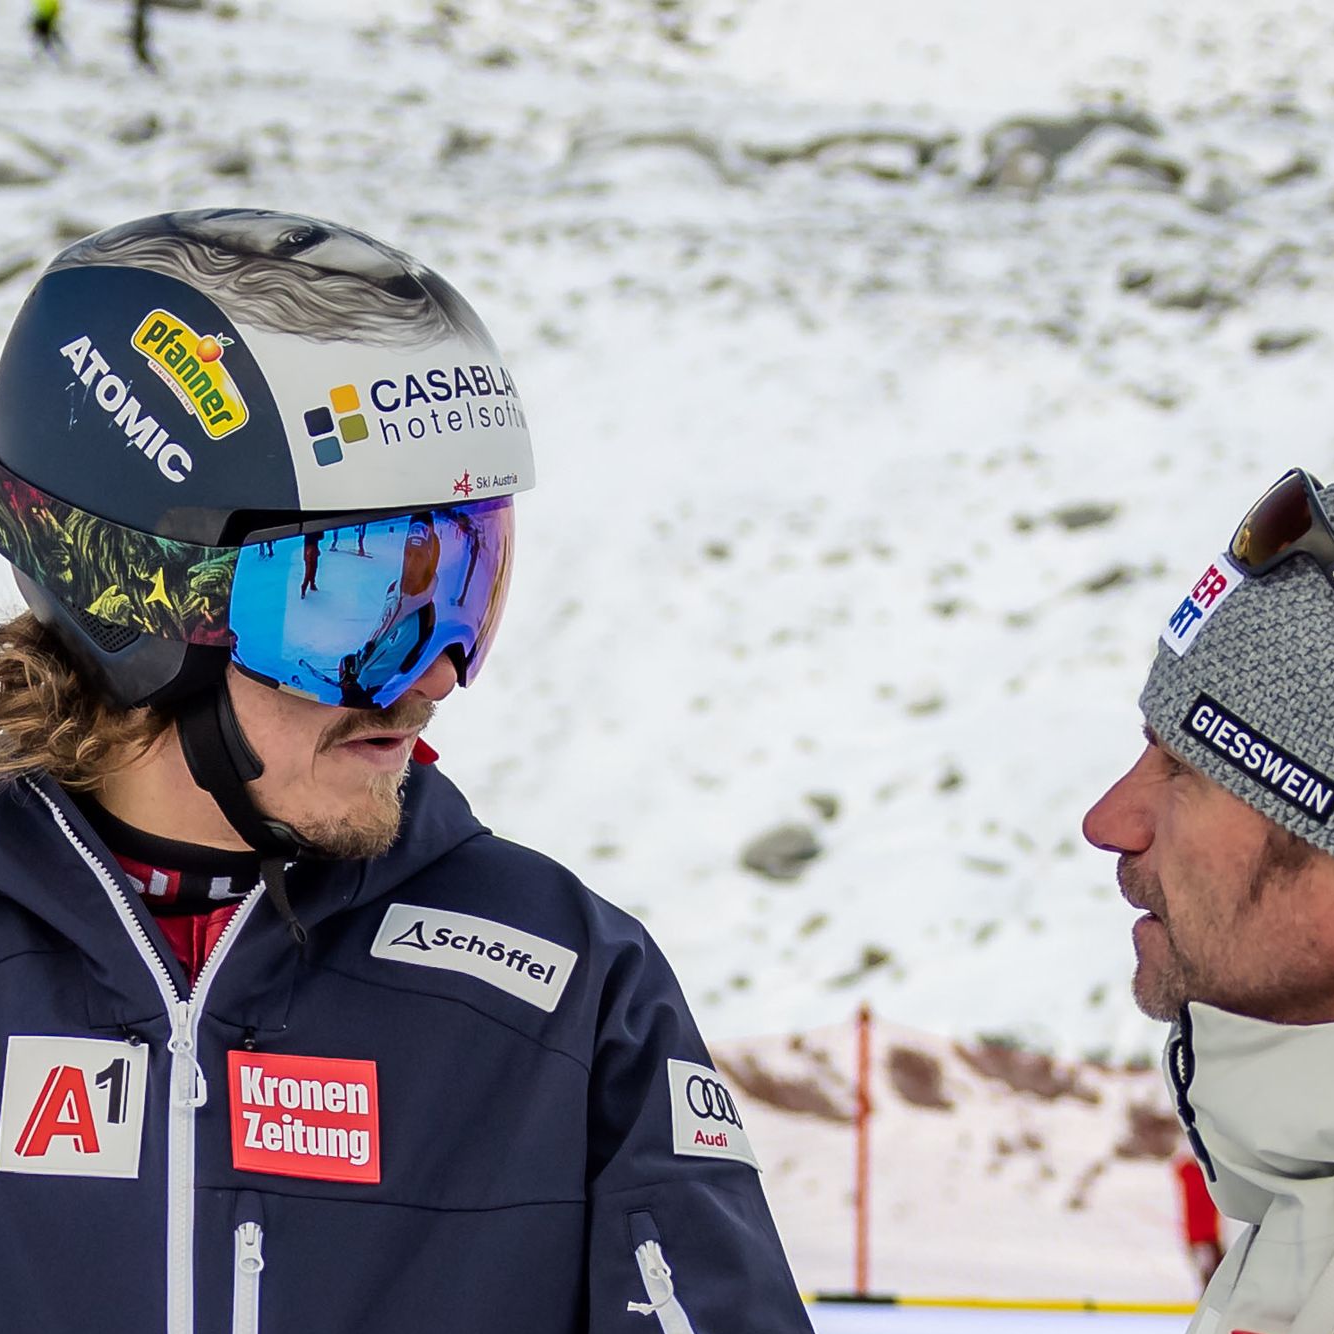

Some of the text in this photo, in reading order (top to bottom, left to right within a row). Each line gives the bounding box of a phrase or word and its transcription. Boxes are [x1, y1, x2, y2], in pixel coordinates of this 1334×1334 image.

[141, 319, 234, 426] pfanner
[60, 335, 193, 483] ATOMIC
[476, 473, 518, 489] Ski Austria
[1191, 705, 1333, 814] GIESSWEIN
[431, 927, 557, 984] Schöffel
[240, 1065, 370, 1115] Kronen
[242, 1110, 371, 1166] Zeitung
[694, 1129, 728, 1148] Audi
